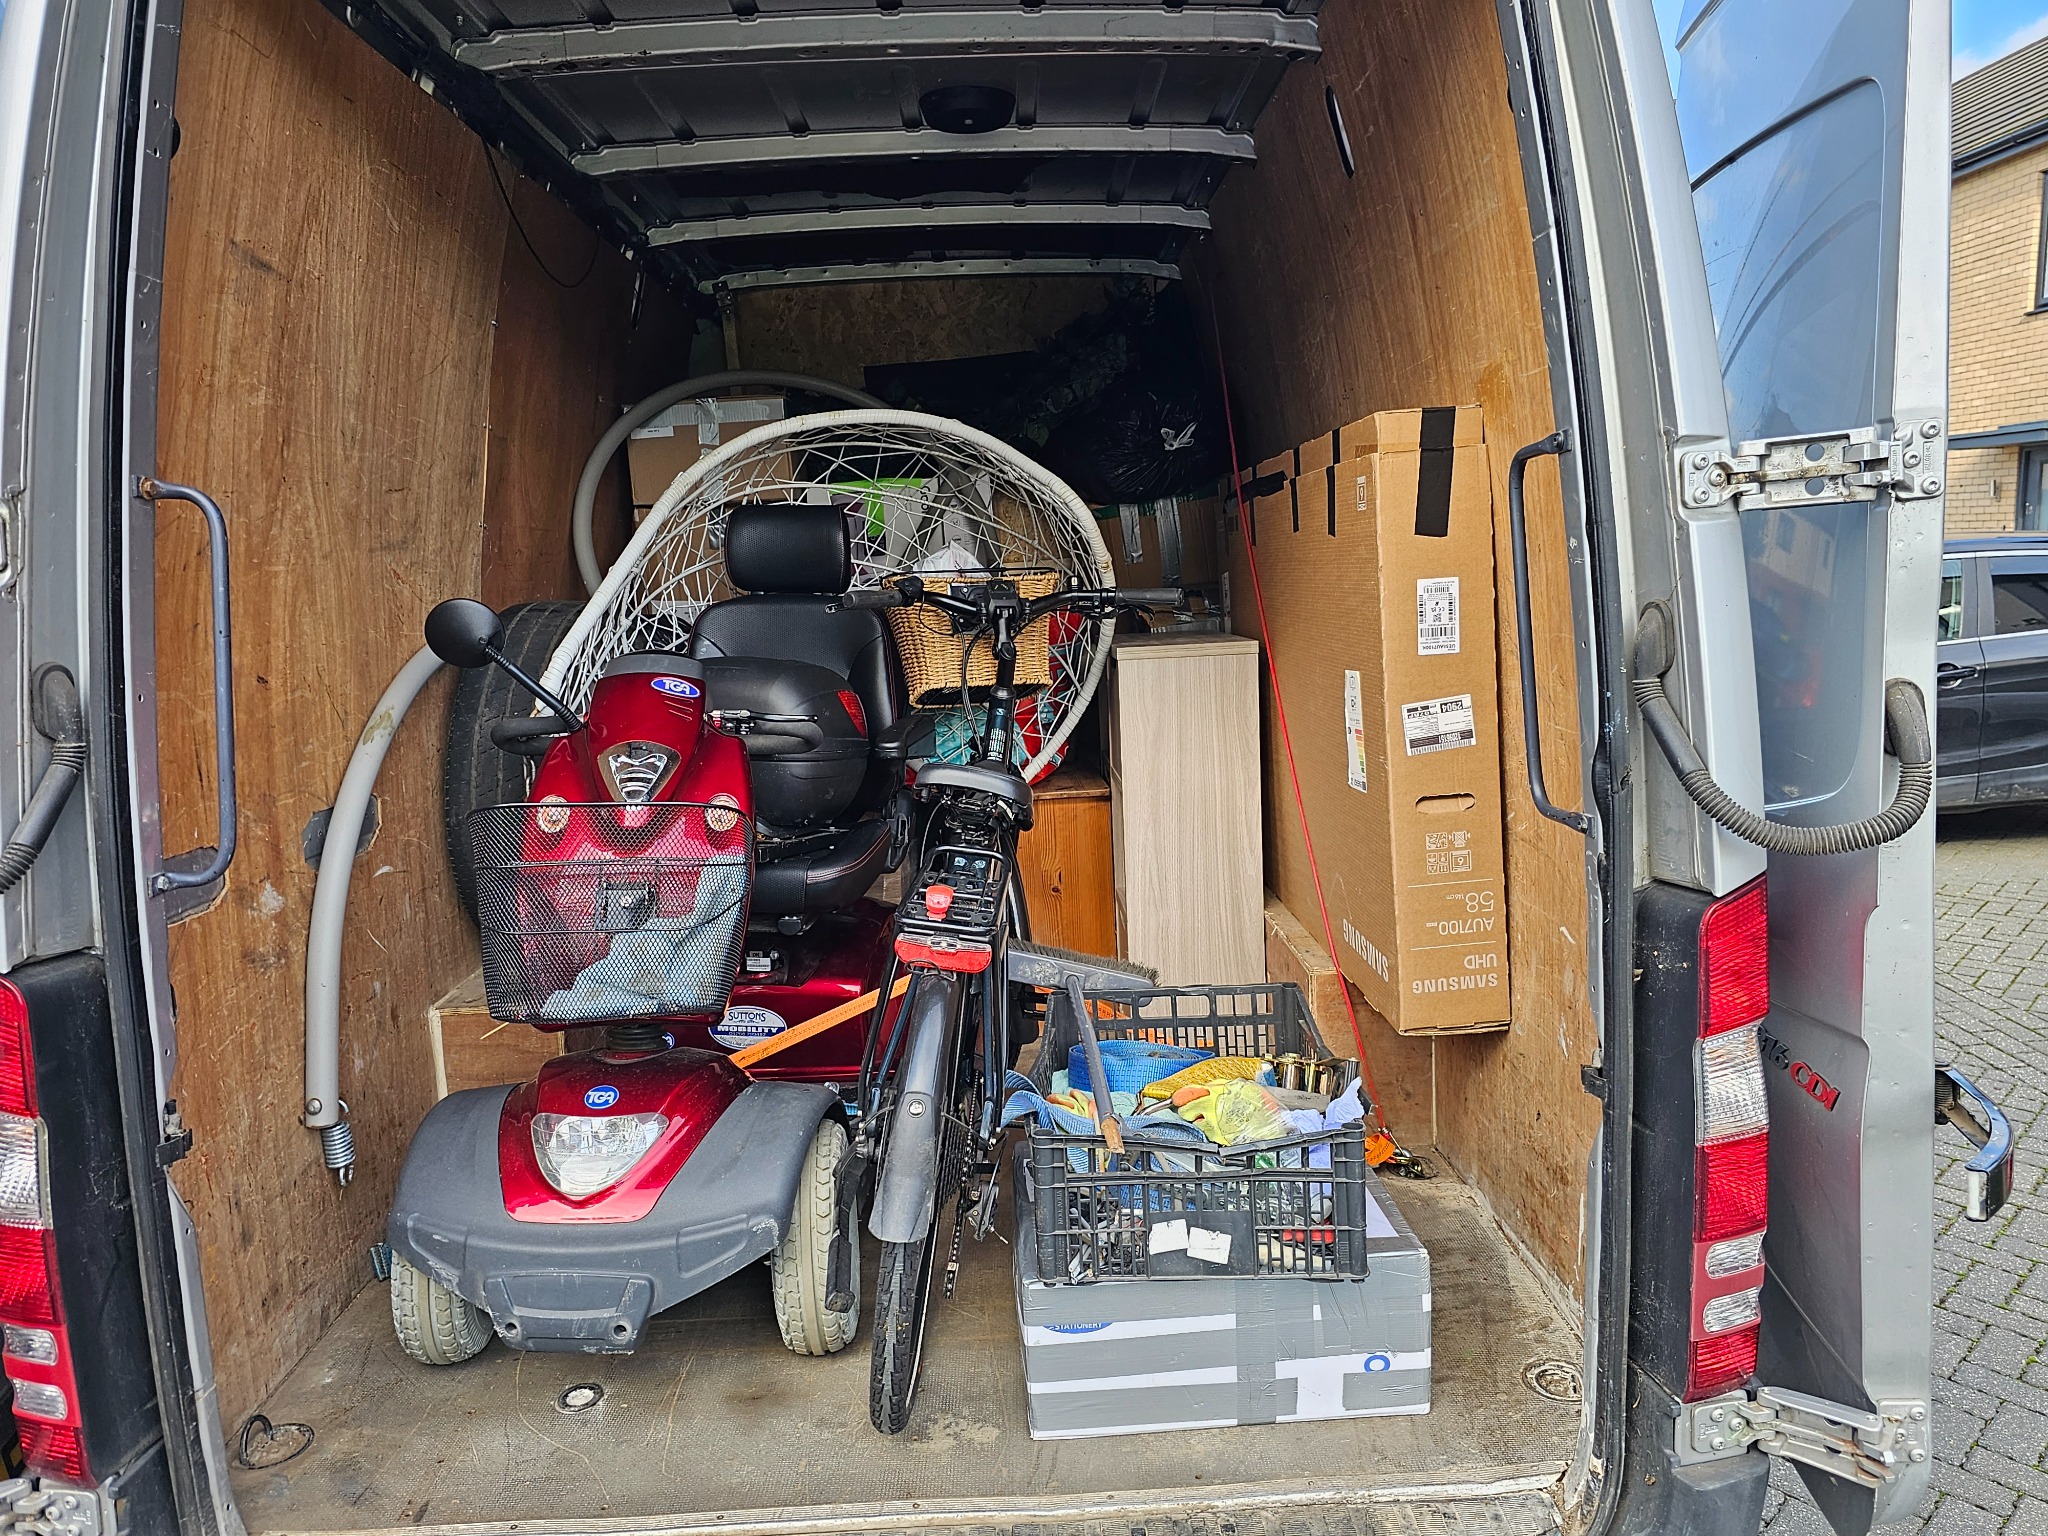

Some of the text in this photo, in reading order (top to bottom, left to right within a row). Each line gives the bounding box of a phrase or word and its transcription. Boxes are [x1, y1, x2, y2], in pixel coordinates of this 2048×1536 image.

[663, 680, 690, 695] TGA
[1441, 701, 1462, 713] 2904
[1465, 891, 1494, 913] 58
[1438, 916, 1495, 935] AU7100
[1343, 918, 1389, 983] SAMSUNG
[1463, 953, 1497, 970] UHD
[1412, 972, 1498, 994] SAMSUNG
[728, 1011, 766, 1022] SUTTONS
[717, 1025, 779, 1034] MOBILITY
[1789, 1061, 1841, 1112] CDI
[587, 1091, 615, 1104] TGA
